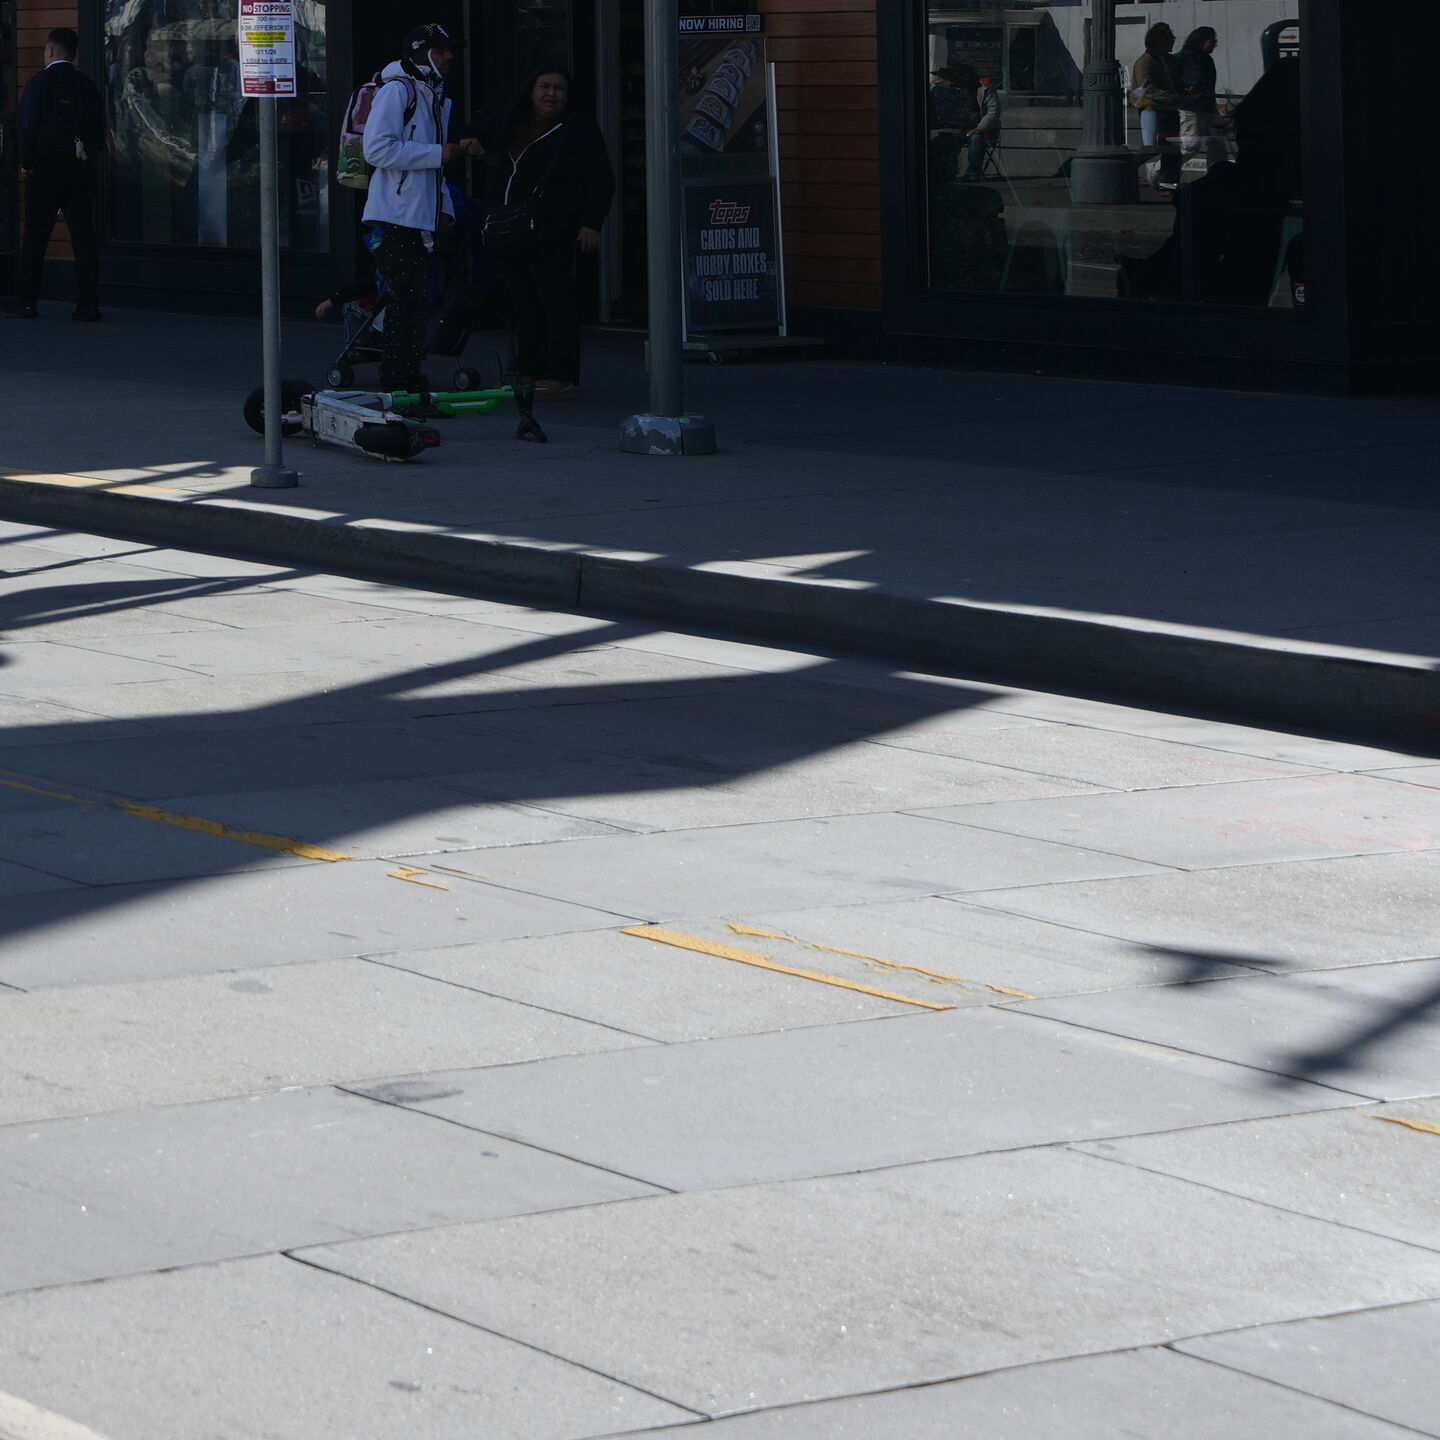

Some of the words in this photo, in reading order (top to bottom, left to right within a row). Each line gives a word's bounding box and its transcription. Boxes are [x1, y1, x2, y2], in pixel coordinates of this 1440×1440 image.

[242, 4, 253, 13] NO
[254, 4, 290, 13] STOPPING
[679, 18, 705, 30] NOW
[708, 17, 744, 29] HIRING
[700, 227, 735, 250] CARDS
[737, 227, 760, 249] AND
[696, 253, 731, 277] HOBBY
[732, 251, 767, 275] BOXES
[705, 279, 731, 302] SOLD
[733, 278, 759, 300] HERE
